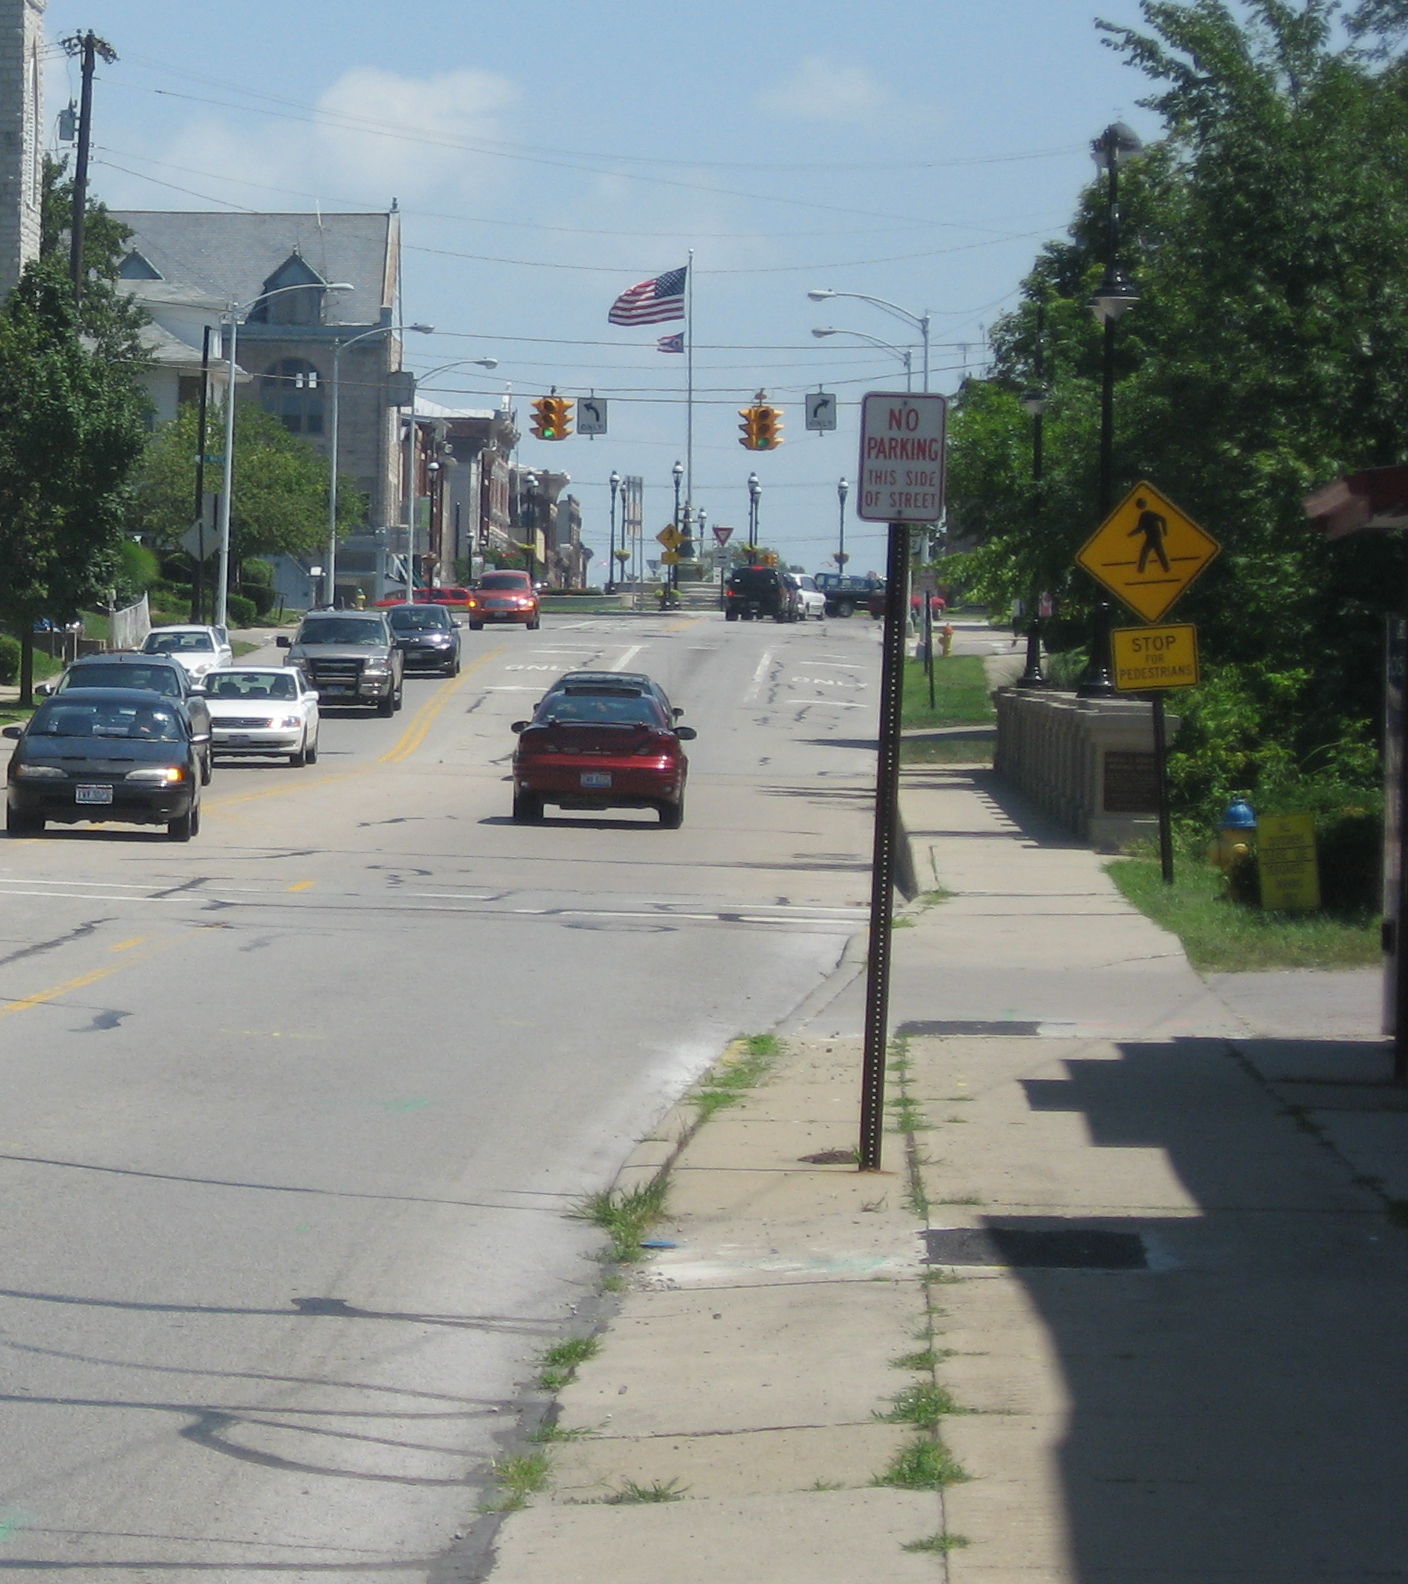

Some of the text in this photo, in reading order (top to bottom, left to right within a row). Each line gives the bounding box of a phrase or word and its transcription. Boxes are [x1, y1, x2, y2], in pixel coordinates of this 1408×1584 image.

[580, 423, 603, 431] ONLY
[889, 407, 919, 431] NO
[867, 437, 939, 461] PARKING
[868, 469, 936, 487] THIS SIDE
[865, 491, 936, 508] OF STREET
[1132, 635, 1176, 653] STOP
[1145, 653, 1164, 664] FOR
[504, 664, 579, 672] ONLY
[1120, 664, 1192, 681] PEDESTRIANS
[792, 677, 868, 689] ONLY
